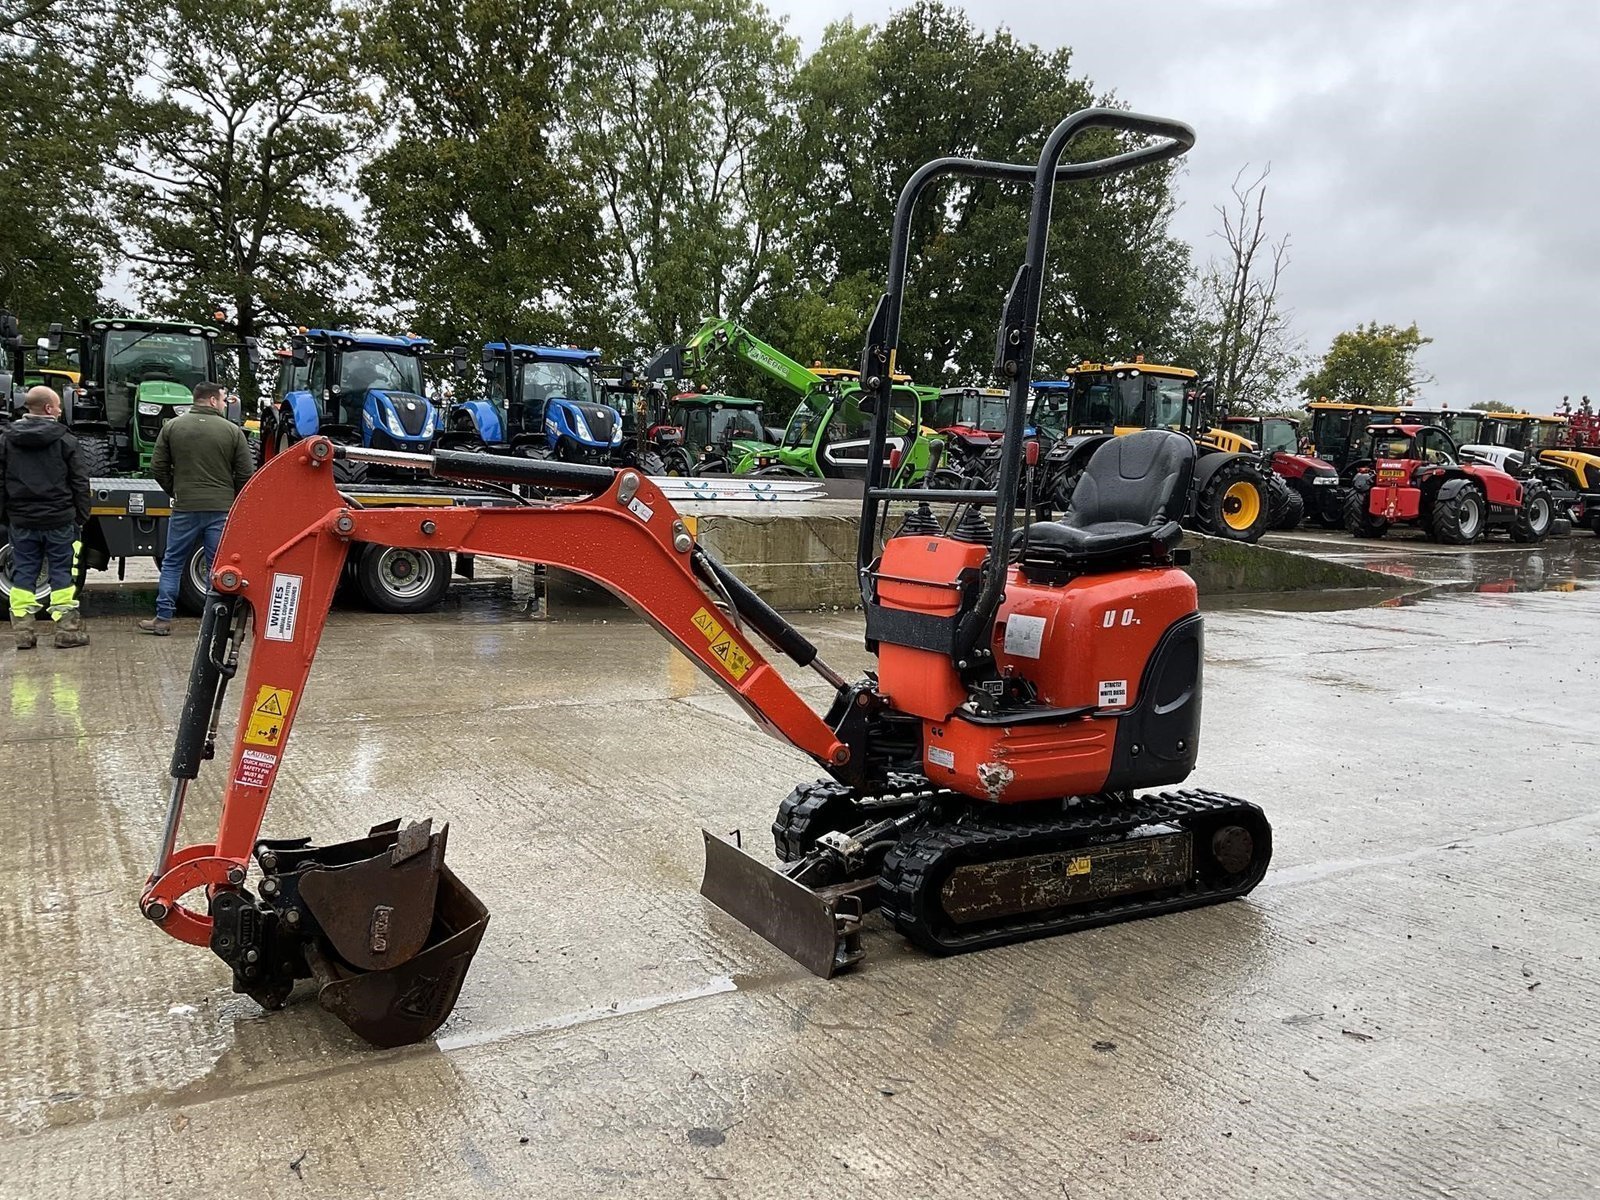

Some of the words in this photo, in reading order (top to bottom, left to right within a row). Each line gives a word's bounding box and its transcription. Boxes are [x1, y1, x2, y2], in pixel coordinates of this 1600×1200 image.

[760, 353, 789, 374] MERLO
[270, 586, 284, 627] WHITES
[290, 586, 298, 607] REQUIRED
[246, 751, 275, 761] CAUTION
[243, 764, 261, 772] SAFETY
